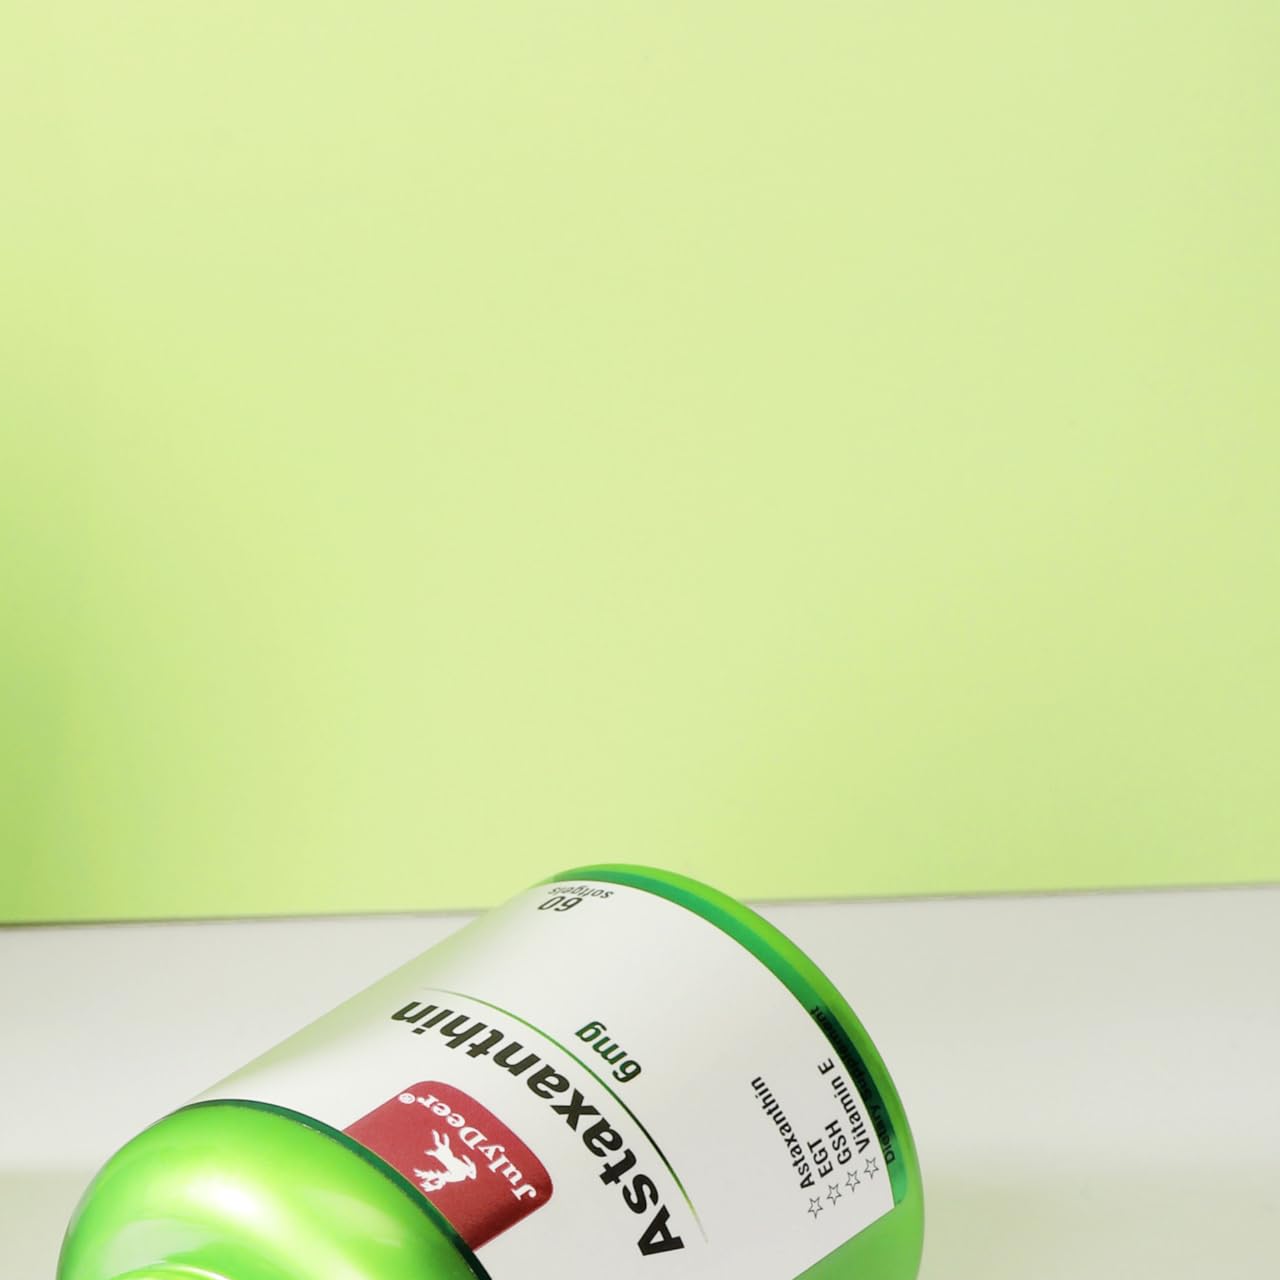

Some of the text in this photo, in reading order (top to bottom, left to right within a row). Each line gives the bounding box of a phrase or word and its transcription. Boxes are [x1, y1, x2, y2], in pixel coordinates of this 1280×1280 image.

[537, 896, 583, 912] 60
[574, 1021, 643, 1084] 6mg
[391, 1000, 685, 1257] Astaxanthin
[750, 1076, 816, 1190] Astaxanthin
[817, 1058, 871, 1154] Vitamin E
[807, 1138, 834, 1179] EGT
[824, 1119, 852, 1165] GSH
